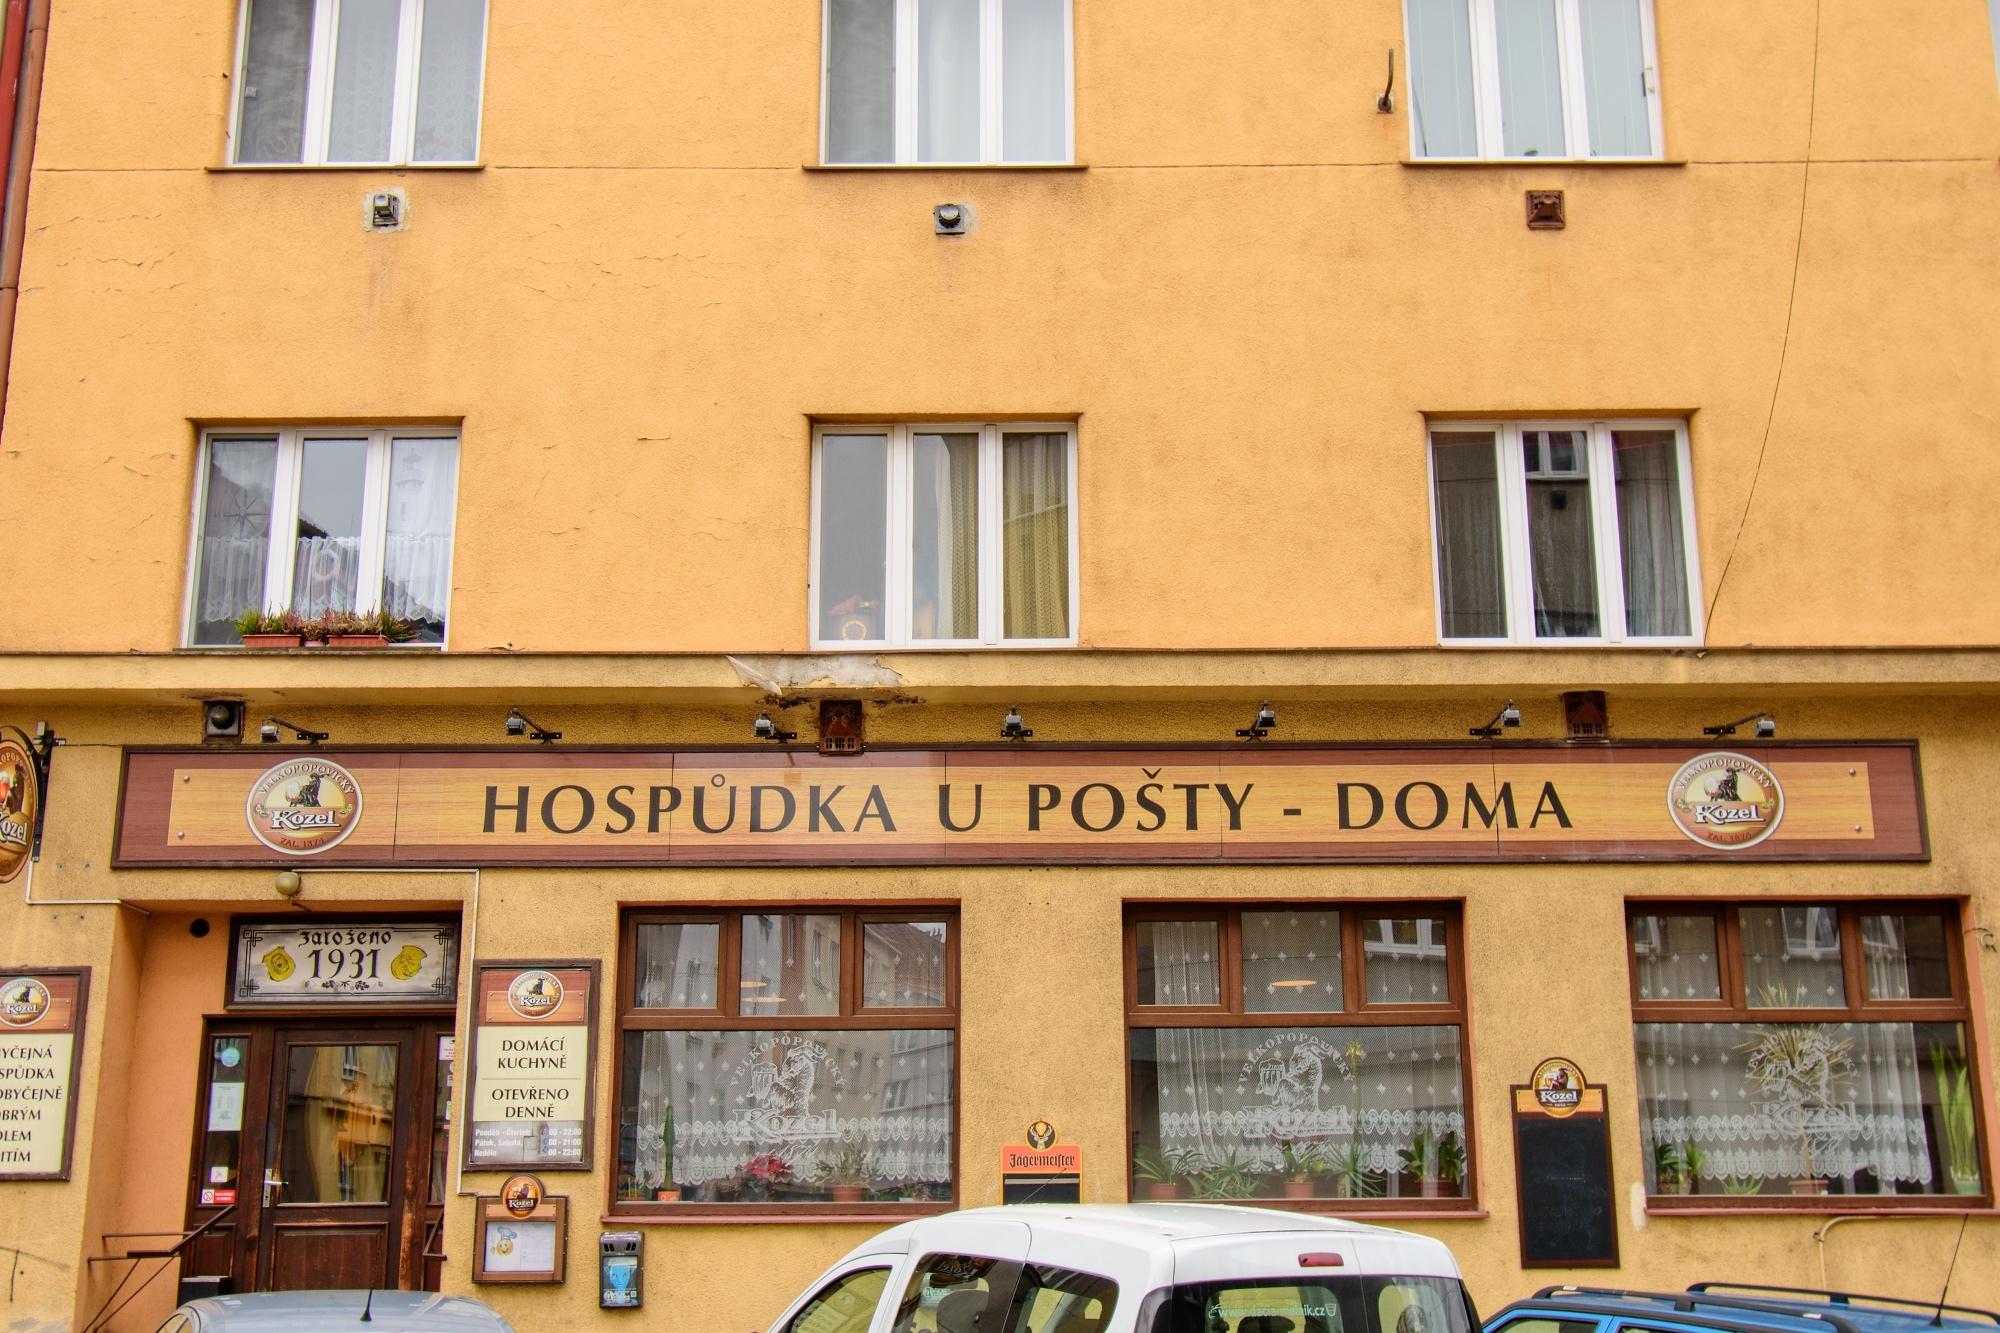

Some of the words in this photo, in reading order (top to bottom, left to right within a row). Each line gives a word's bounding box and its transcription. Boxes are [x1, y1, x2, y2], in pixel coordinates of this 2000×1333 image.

[482, 774, 897, 833] HOSPŮDKA
[938, 783, 983, 832] U
[1028, 768, 1254, 832] POŠTY
[1336, 781, 1573, 831] DOMA
[271, 810, 341, 830] Kozel
[1696, 804, 1765, 826] Kozel
[307, 949, 381, 979] 1931
[0, 1044, 53, 1060] YČEJNÁ
[502, 1036, 566, 1052] DOMÁCÍ
[497, 1054, 567, 1069] KUCHYNĚ
[491, 1085, 569, 1101] OTEVŘENO
[1540, 1090, 1578, 1103] Kozel
[0, 1106, 41, 1121] BRÝM
[505, 1103, 555, 1118] DENNĚ
[732, 1106, 841, 1143] Kozel
[509, 1199, 533, 1208] Kozel
